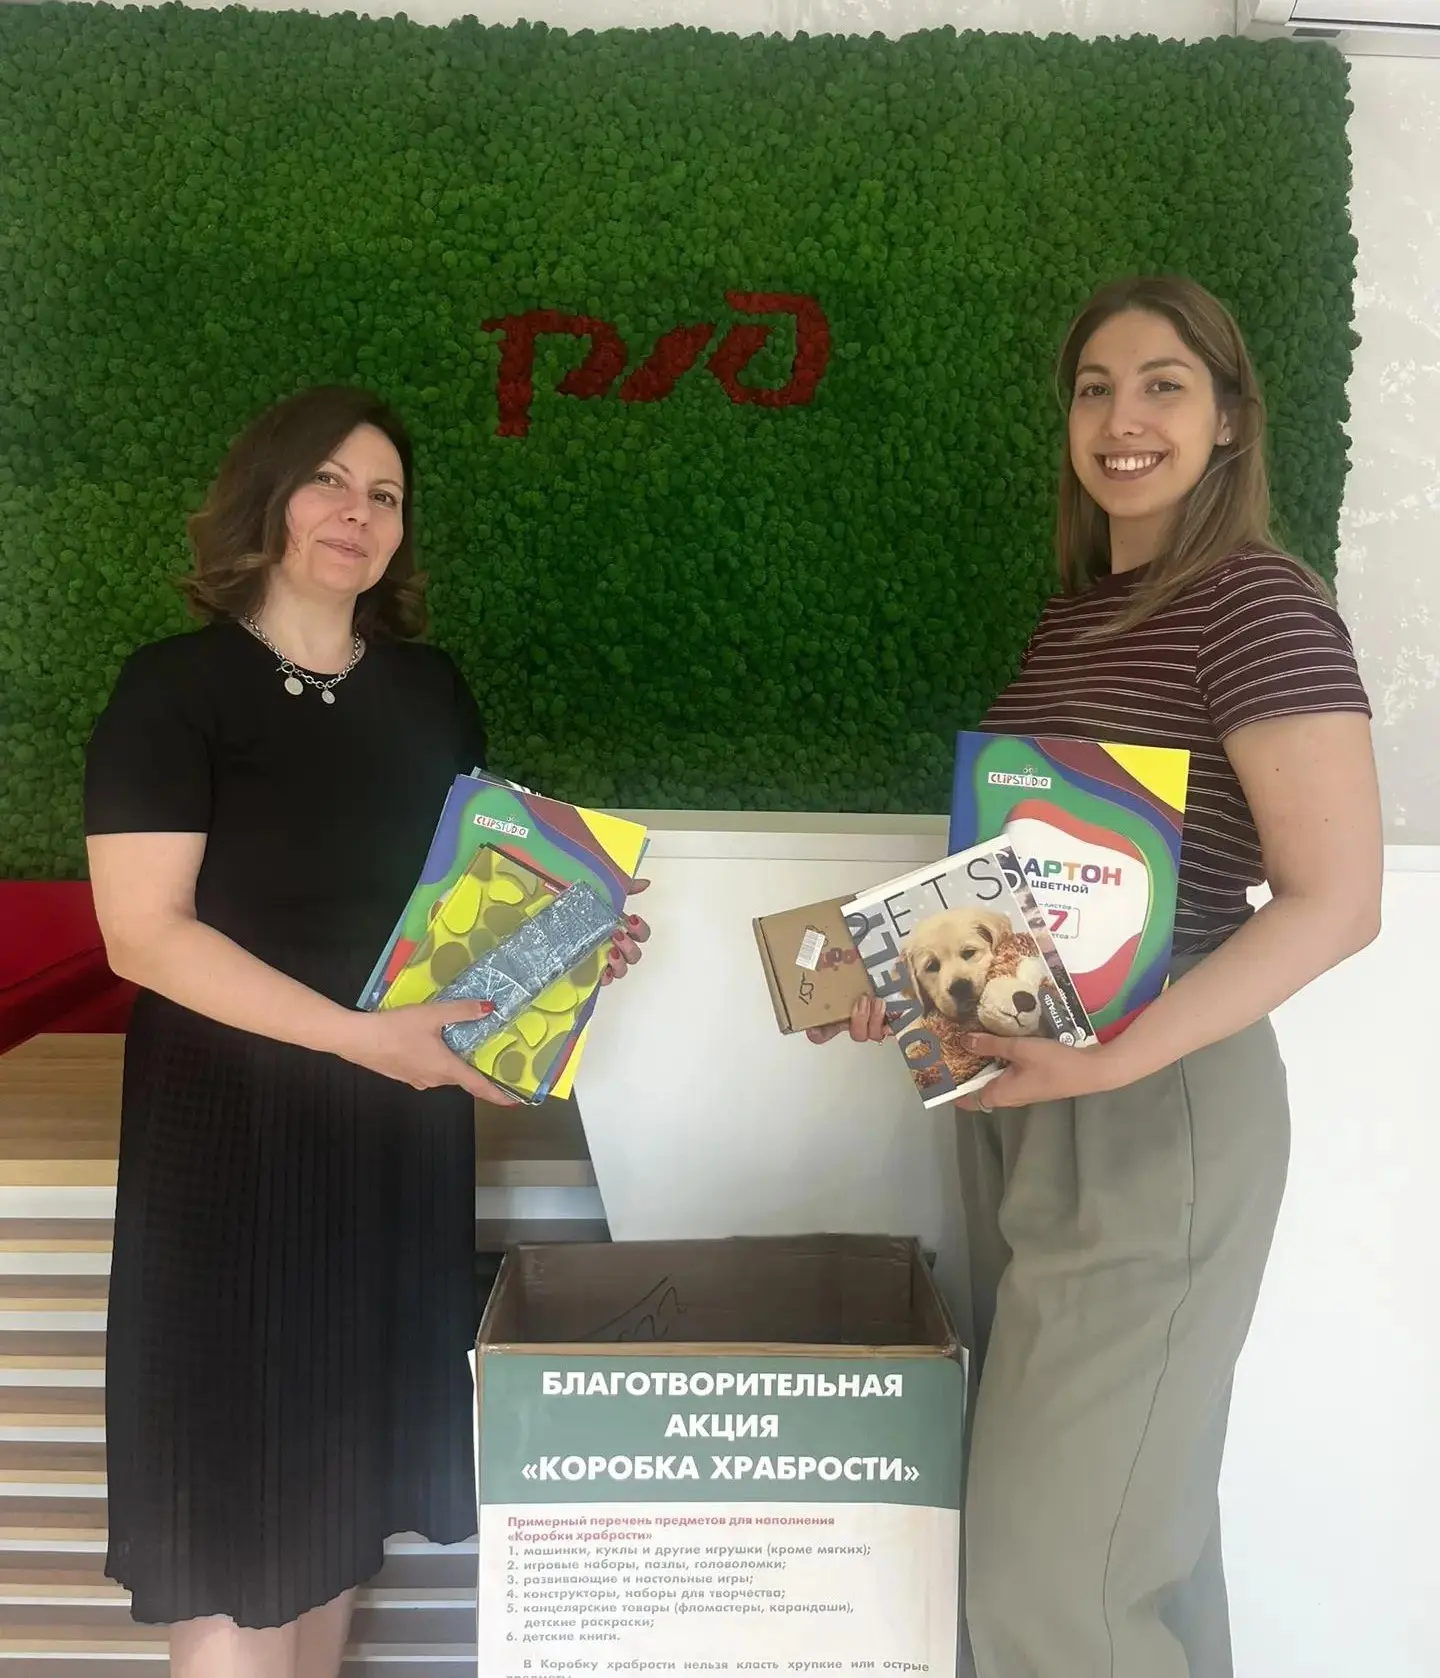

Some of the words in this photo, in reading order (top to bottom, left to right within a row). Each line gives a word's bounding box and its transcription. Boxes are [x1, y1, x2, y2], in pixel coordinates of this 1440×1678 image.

[1020, 857, 1122, 886] АРТОН
[1031, 881, 1089, 894] ЦВЕТНОЙ
[1048, 909, 1068, 932] 7
[1043, 993, 1064, 1030] ТЕТРАДЬ
[542, 1371, 903, 1397] БЛАГОТВОРИТЕЛЬНАЯ
[664, 1413, 779, 1442] АКЦИЯ
[521, 1455, 700, 1481] «КОРОБКА
[710, 1455, 920, 1482] ХРАБРОСТИ»
[507, 1515, 588, 1530] Примерный
[589, 1517, 653, 1528] перечень
[654, 1516, 727, 1528] предметов
[728, 1516, 753, 1527] для
[755, 1516, 835, 1526] наполнения
[507, 1529, 574, 1544] «Коробки
[575, 1529, 653, 1543] храбрости»
[508, 1545, 519, 1557] 1.
[523, 1547, 591, 1557] машинки,
[595, 1546, 638, 1558] куклы
[642, 1546, 651, 1555] и
[654, 1546, 701, 1558] другие
[705, 1545, 763, 1558] игрушки
[766, 1542, 813, 1558] (кроме
[816, 1543, 872, 1557] мягких);
[506, 1559, 519, 1571] 2.
[523, 1561, 580, 1573] игровые
[583, 1558, 640, 1572] наборы,
[644, 1560, 690, 1571] пазлы,
[694, 1559, 787, 1571] головоломки;
[506, 1574, 519, 1586] 3.
[523, 1575, 618, 1587] развивающие
[622, 1575, 631, 1584] и
[635, 1575, 713, 1585] настольные
[717, 1575, 754, 1587] игры;
[506, 1588, 519, 1599] 4.
[523, 1589, 621, 1601] конструкторы,
[624, 1586, 677, 1601] наборы
[680, 1589, 705, 1600] для
[708, 1589, 786, 1602] творчества;
[506, 1602, 519, 1614] 5.
[523, 1603, 618, 1615] канцелярские
[621, 1604, 670, 1615] товары
[674, 1601, 765, 1615] (фломастеры,
[769, 1601, 854, 1615] карандаши),
[523, 1619, 577, 1630] детские
[580, 1618, 655, 1630] раскраски;
[505, 1631, 518, 1642] 6.
[522, 1633, 575, 1644] детские
[579, 1632, 621, 1642] книги.
[523, 1658, 532, 1669] В
[540, 1658, 599, 1672] Коробку
[606, 1658, 676, 1672] храбрости
[683, 1661, 729, 1670] нельзя
[736, 1661, 780, 1670] класть
[786, 1661, 843, 1672] хрупкие
[850, 1660, 875, 1669] или
[882, 1660, 930, 1675] острые
